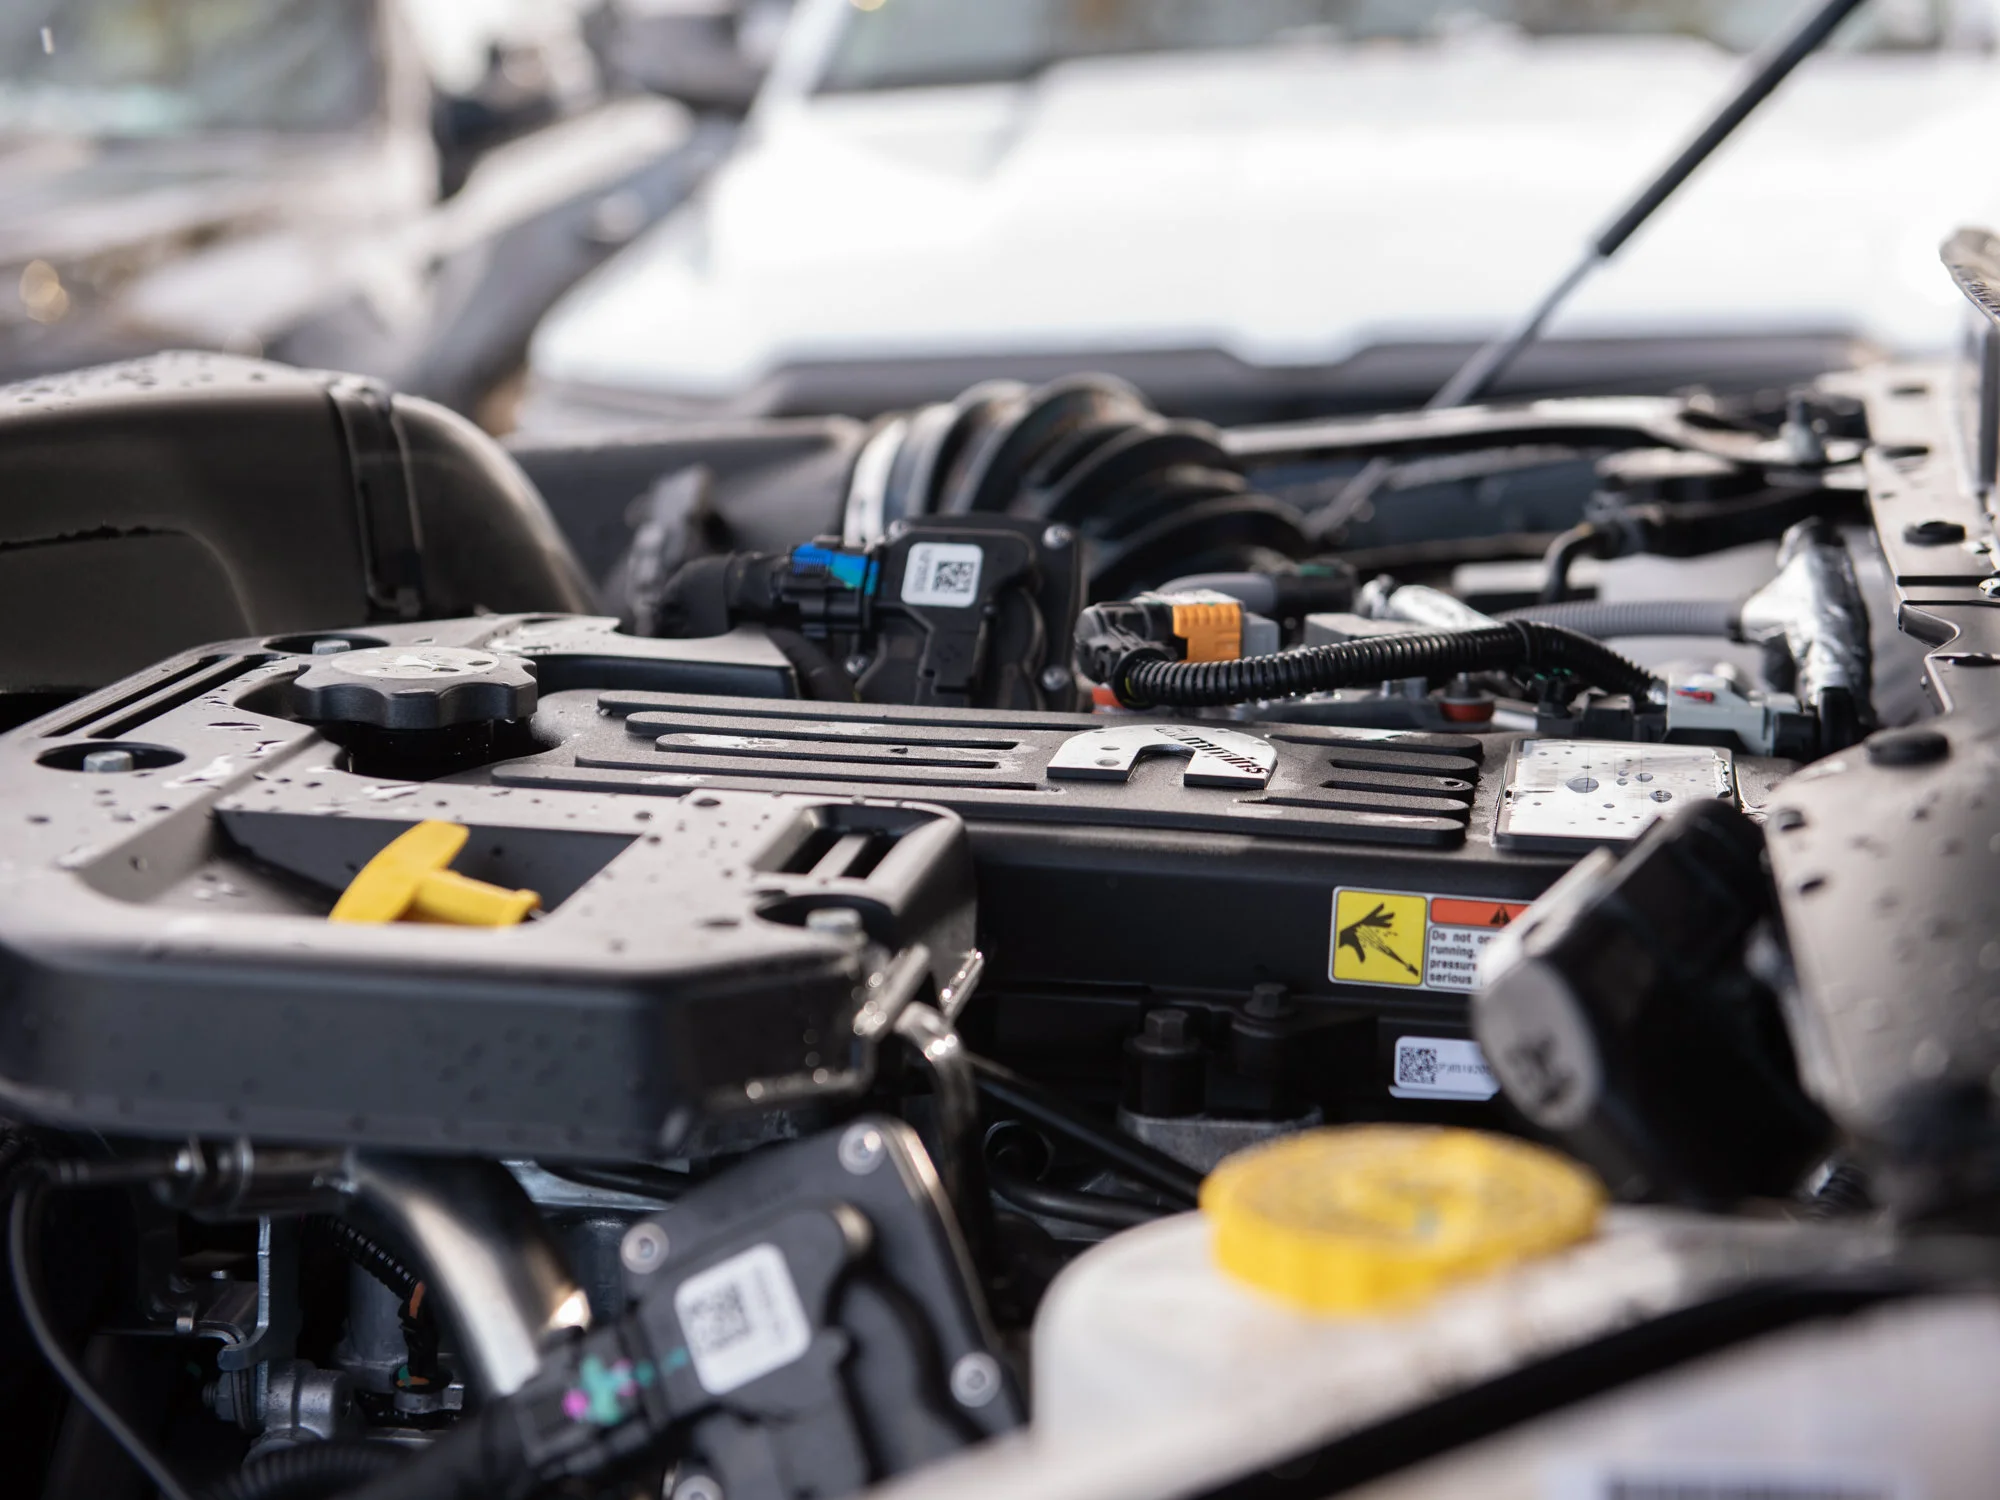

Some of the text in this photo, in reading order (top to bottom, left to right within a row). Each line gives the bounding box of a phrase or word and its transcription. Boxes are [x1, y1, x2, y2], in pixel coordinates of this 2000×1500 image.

[1432, 930, 1446, 941] Do
[1452, 933, 1471, 943] not
[1430, 973, 1472, 985] serious
